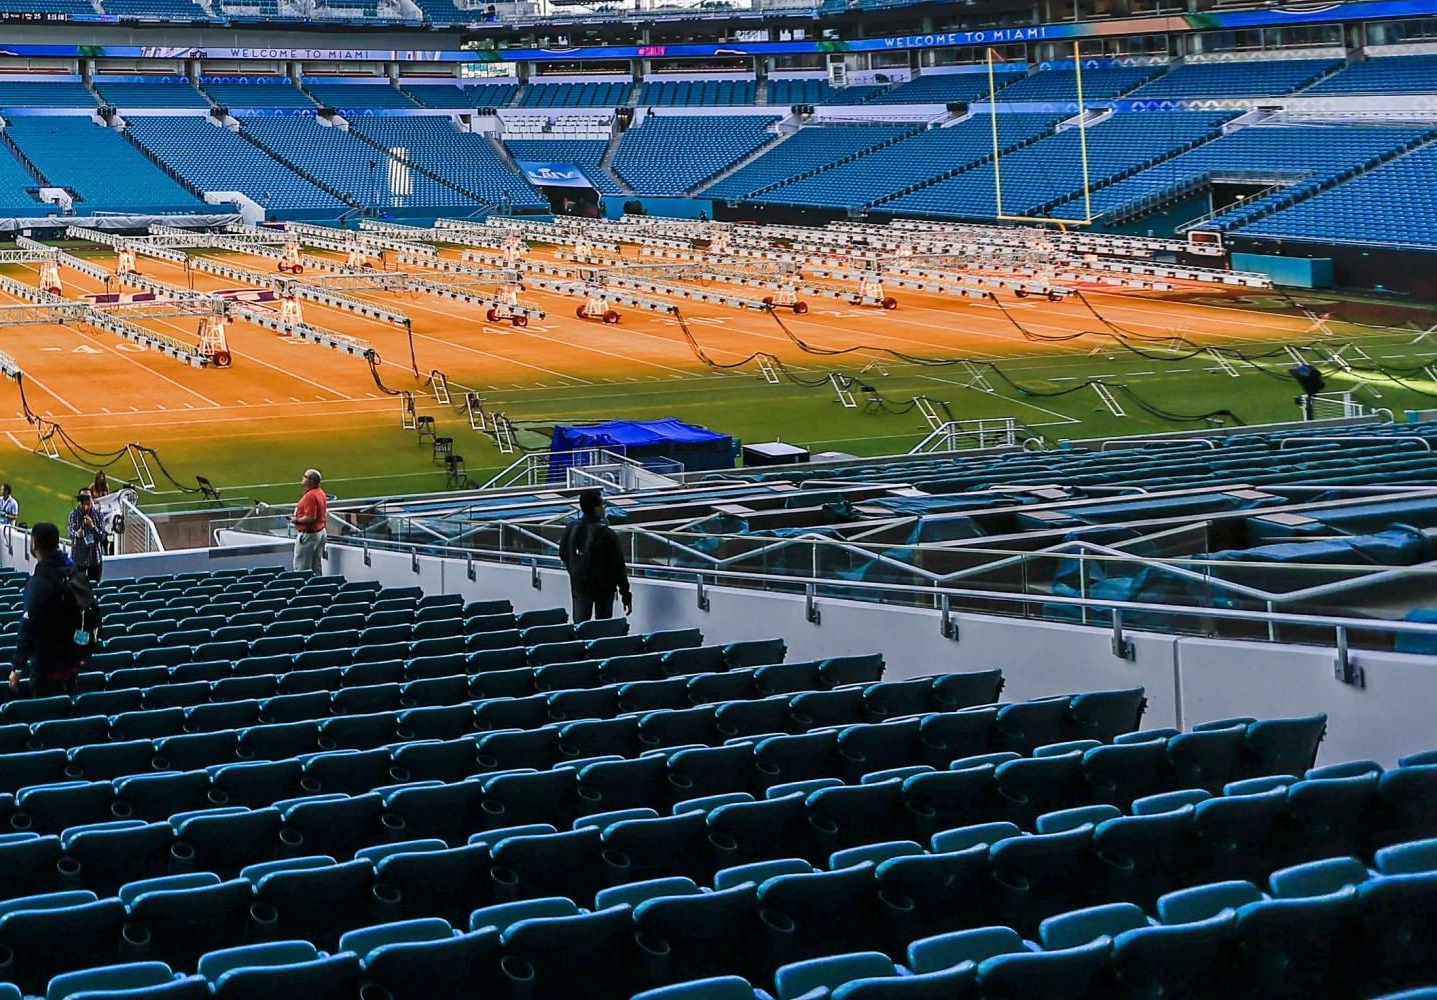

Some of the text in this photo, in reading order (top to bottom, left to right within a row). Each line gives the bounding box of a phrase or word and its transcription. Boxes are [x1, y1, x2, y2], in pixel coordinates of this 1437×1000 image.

[884, 26, 1046, 48] WELCOME TO MIAMI
[231, 49, 369, 59] WELCOME TO MIAMI
